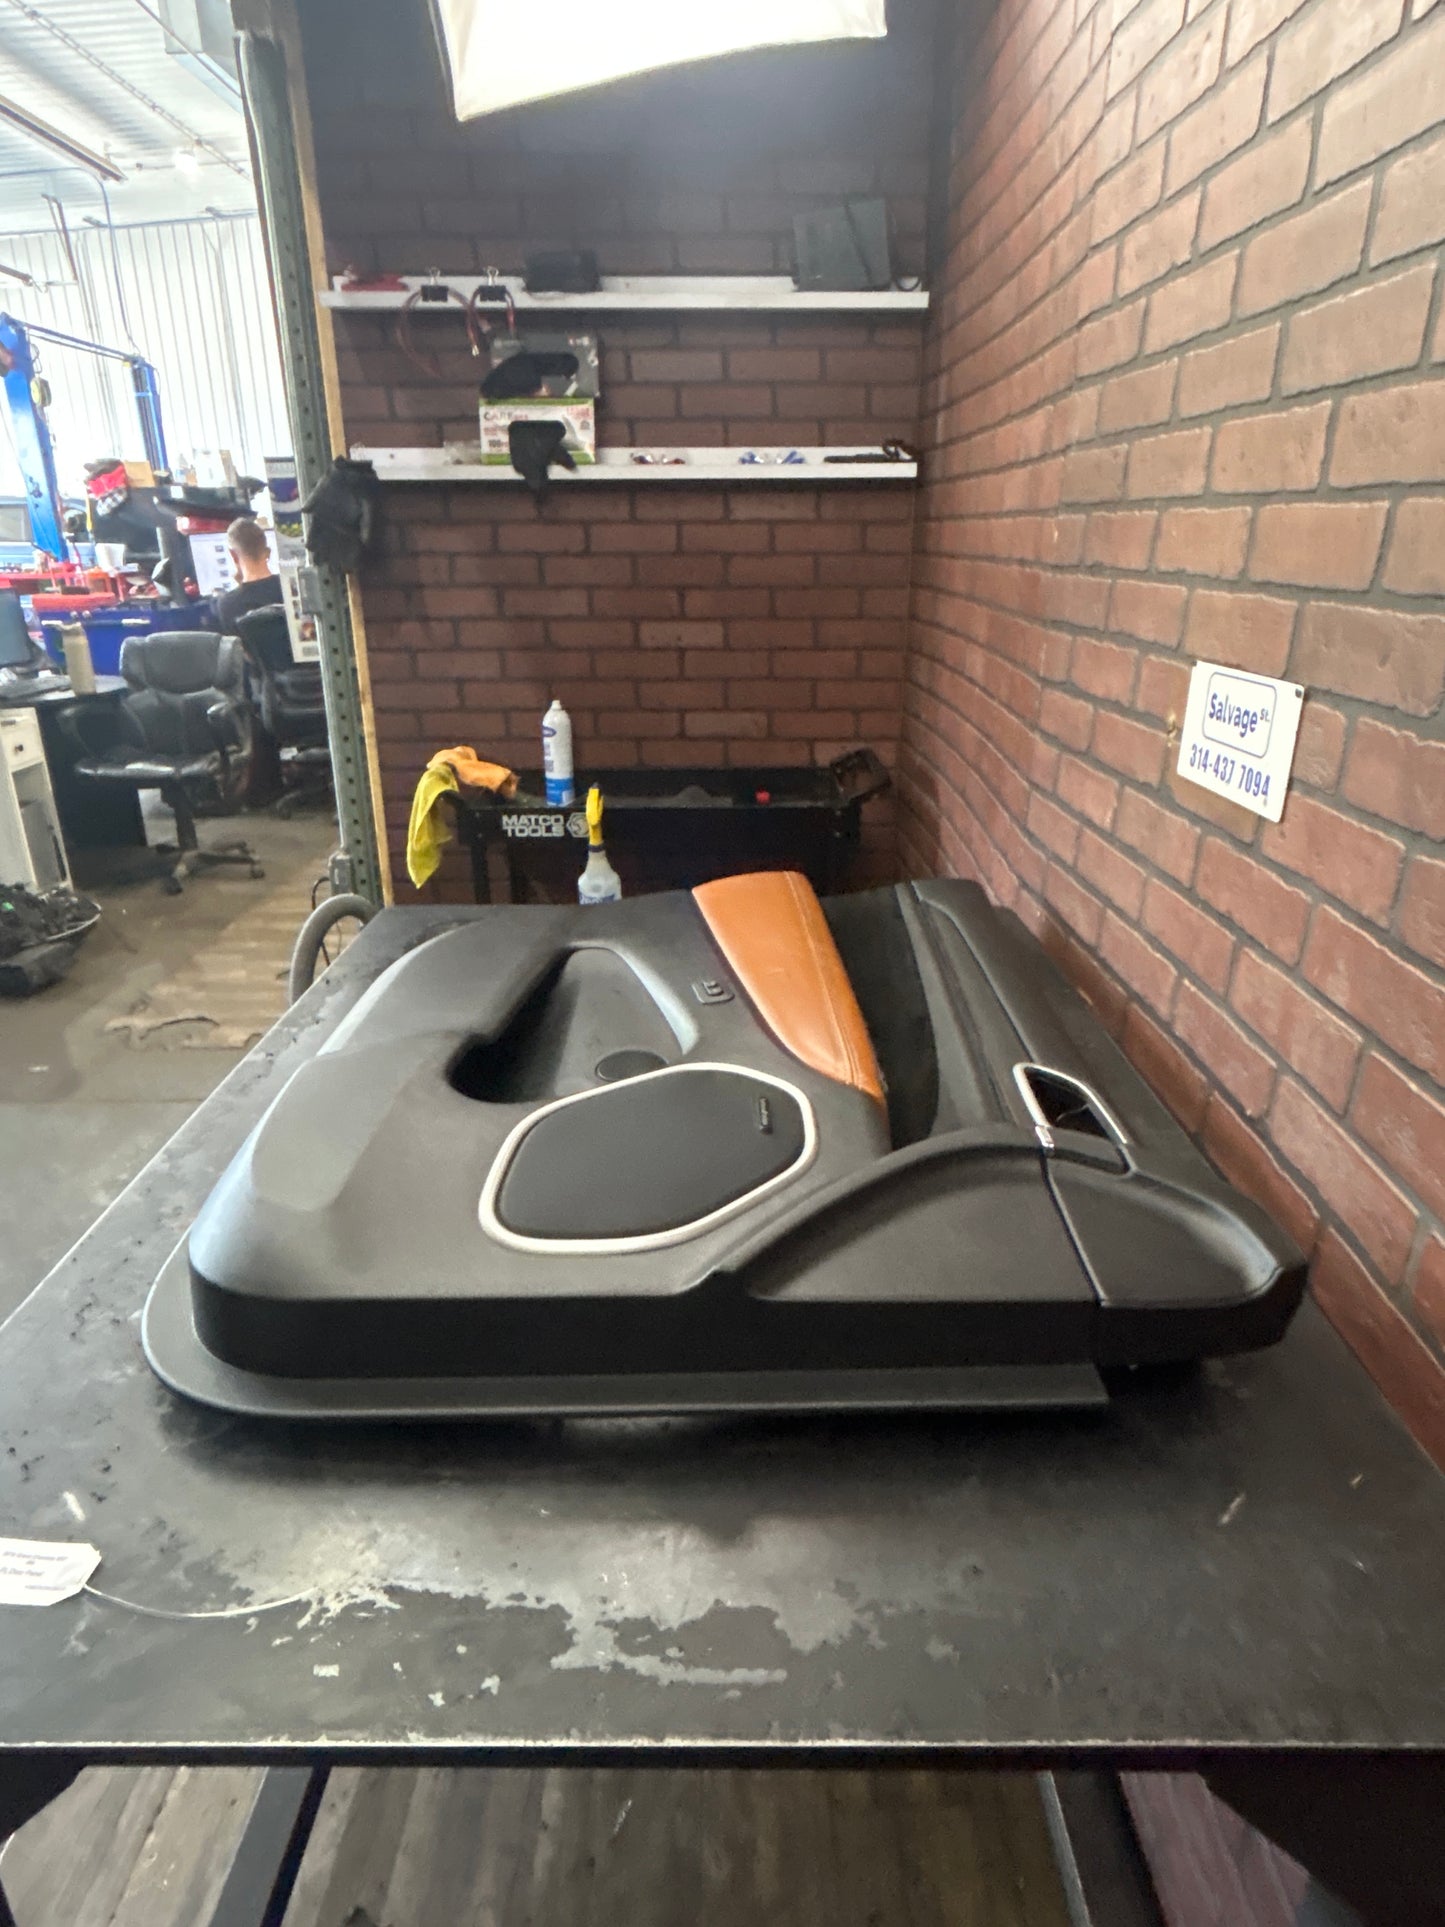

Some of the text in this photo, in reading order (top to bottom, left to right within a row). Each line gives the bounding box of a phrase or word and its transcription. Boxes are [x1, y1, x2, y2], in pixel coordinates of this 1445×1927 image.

[1209, 693, 1258, 738] Salvage
[1190, 744, 1271, 797] 314-437 7094
[502, 815, 564, 826] MATCO
[503, 826, 565, 837] TOOLS
